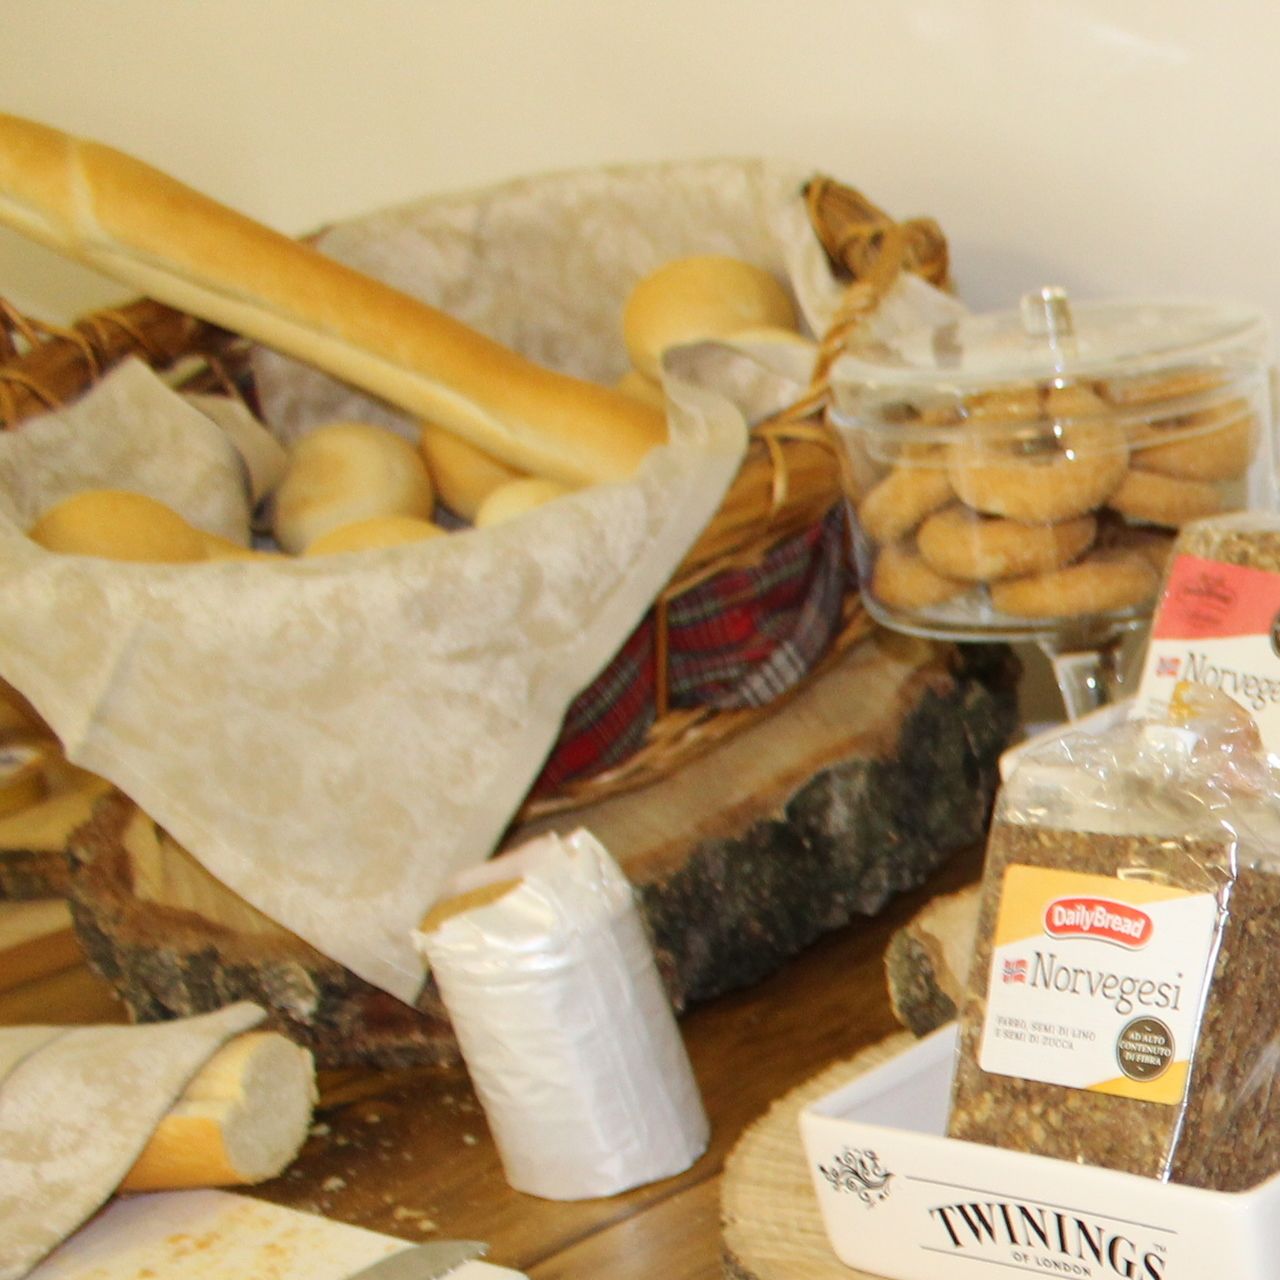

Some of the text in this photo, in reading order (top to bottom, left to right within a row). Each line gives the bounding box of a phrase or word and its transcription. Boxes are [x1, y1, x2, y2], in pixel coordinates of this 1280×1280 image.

[1053, 904, 1146, 938] DailyBread
[1030, 951, 1184, 1016] Norvegesi
[1003, 1030, 1026, 1042] SEMI
[1028, 1034, 1040, 1043] DI
[1041, 1037, 1074, 1050] ZUCCA
[1031, 1022, 1055, 1034] SEMI
[1057, 1026, 1069, 1036] DI
[1072, 1029, 1096, 1042] LINO
[1128, 1032, 1166, 1045] AD ALTO
[1119, 1041, 1173, 1057] CONTENUTO
[1125, 1053, 1162, 1066] DI FIBRA
[1012, 1252, 1093, 1278] OF LONDON
